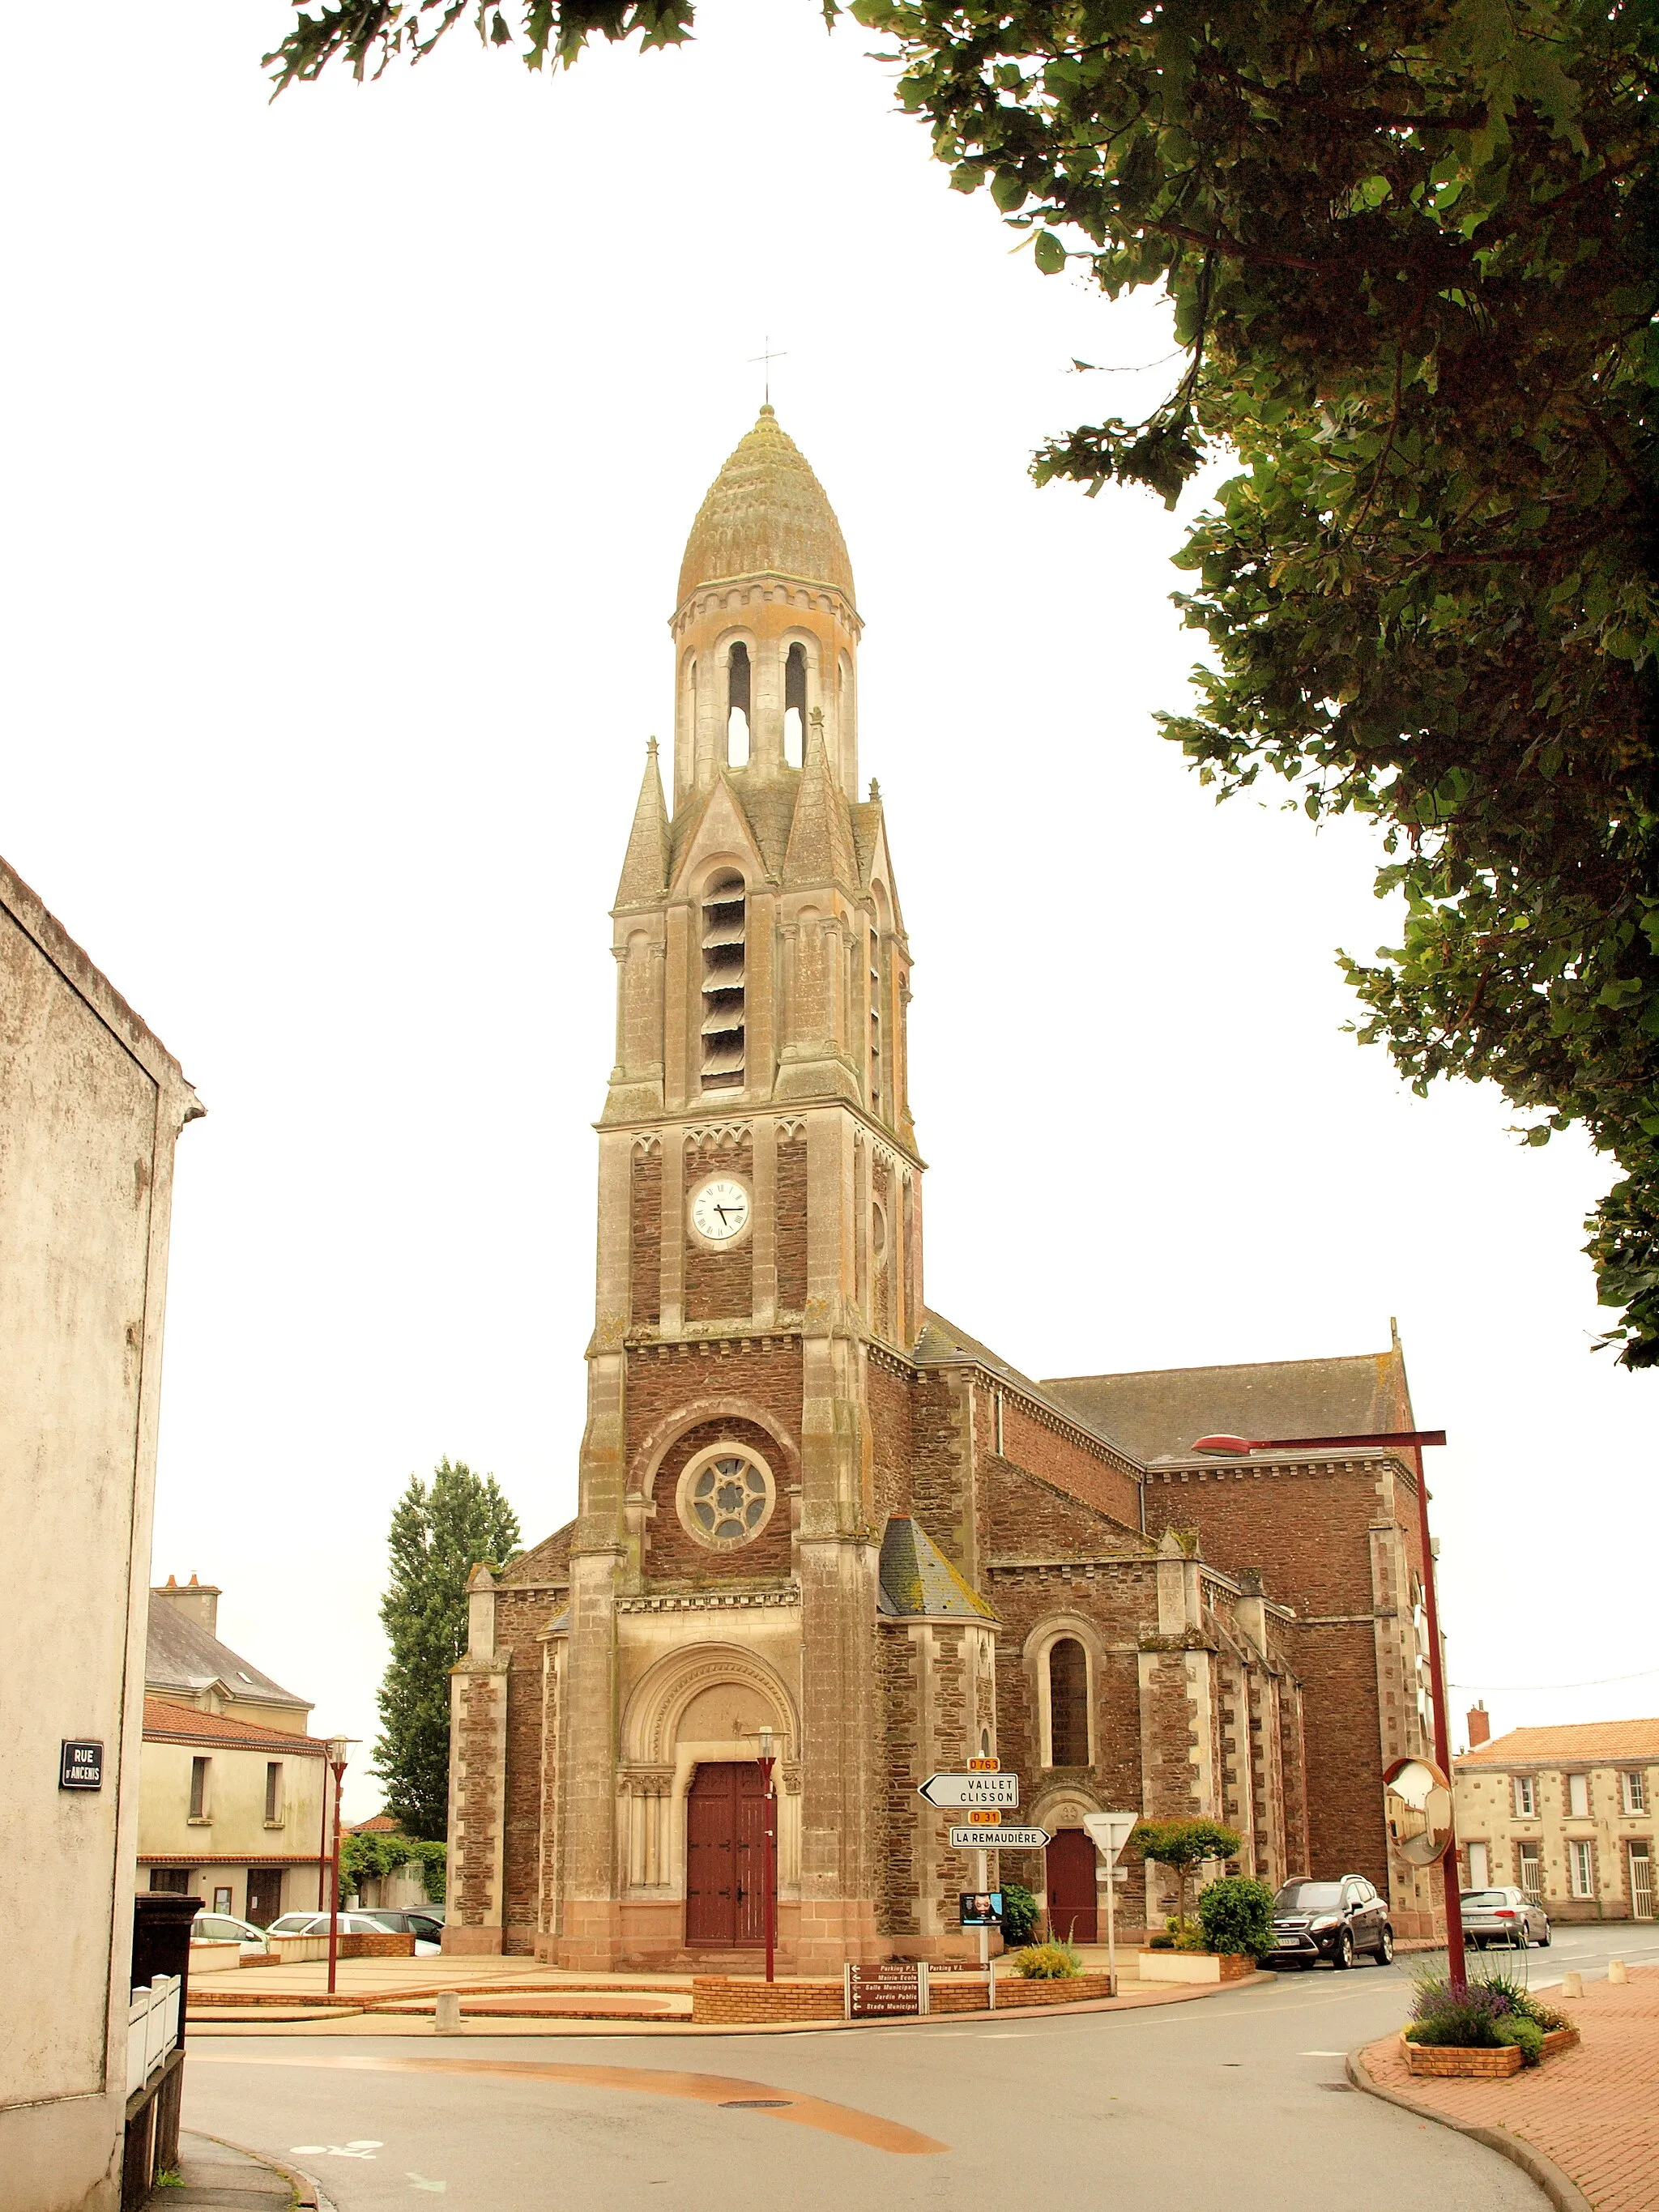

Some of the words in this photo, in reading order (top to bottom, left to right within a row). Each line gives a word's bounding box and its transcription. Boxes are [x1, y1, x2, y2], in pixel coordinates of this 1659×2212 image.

[75, 1749, 94, 1763] RUE
[968, 1780, 1012, 1789] VALLET
[960, 1792, 1013, 1802] CLISSON
[974, 1813, 979, 1822] D
[984, 1813, 996, 1822] 31
[957, 1833, 968, 1843] LA
[972, 1831, 1037, 1843] REMAUDIÈRE
